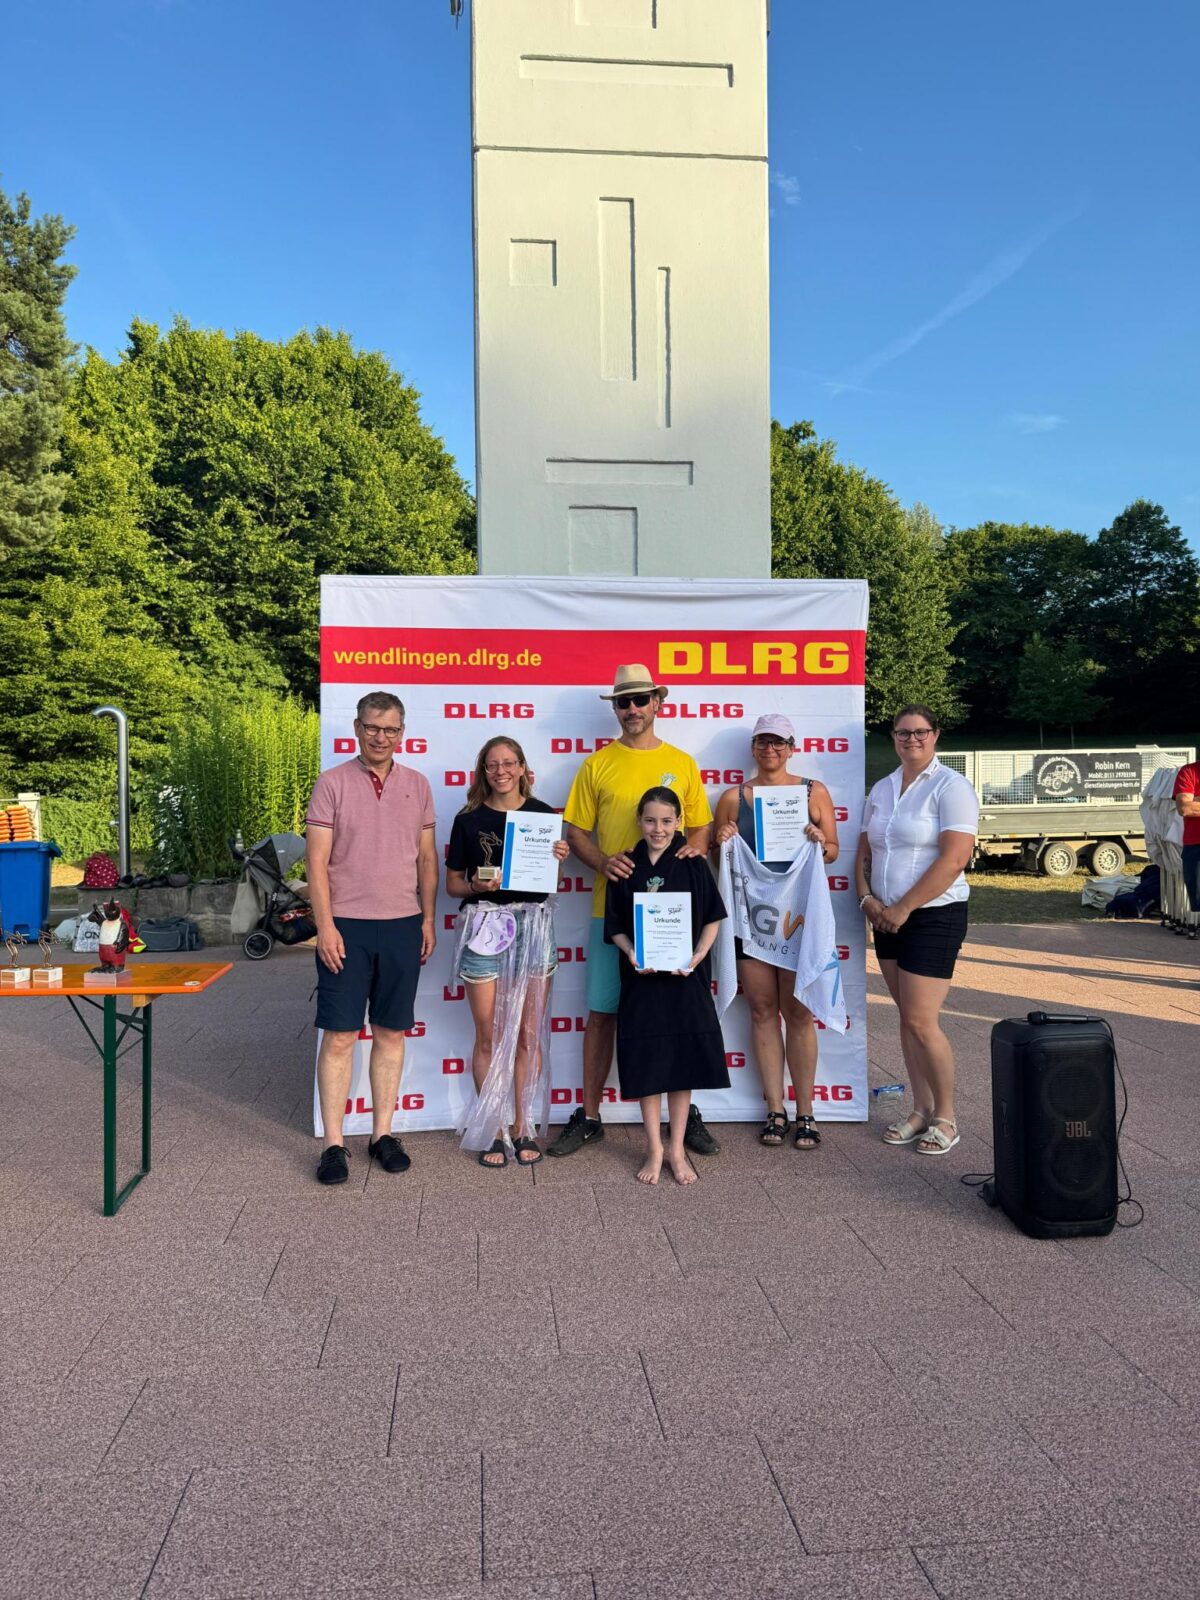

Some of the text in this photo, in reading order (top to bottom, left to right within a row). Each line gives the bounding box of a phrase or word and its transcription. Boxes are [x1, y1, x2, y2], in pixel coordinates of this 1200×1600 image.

[333, 648, 542, 670] wendlingen.dlrg.de
[658, 642, 849, 675] DLRG
[444, 703, 535, 718] DLRG
[656, 703, 744, 718] DLRG
[334, 738, 427, 753] DG
[1094, 761, 1130, 770] Robin Kern
[700, 769, 744, 784] RG
[524, 836, 551, 844] Urkunde
[1064, 1121, 1092, 1138] JBL
